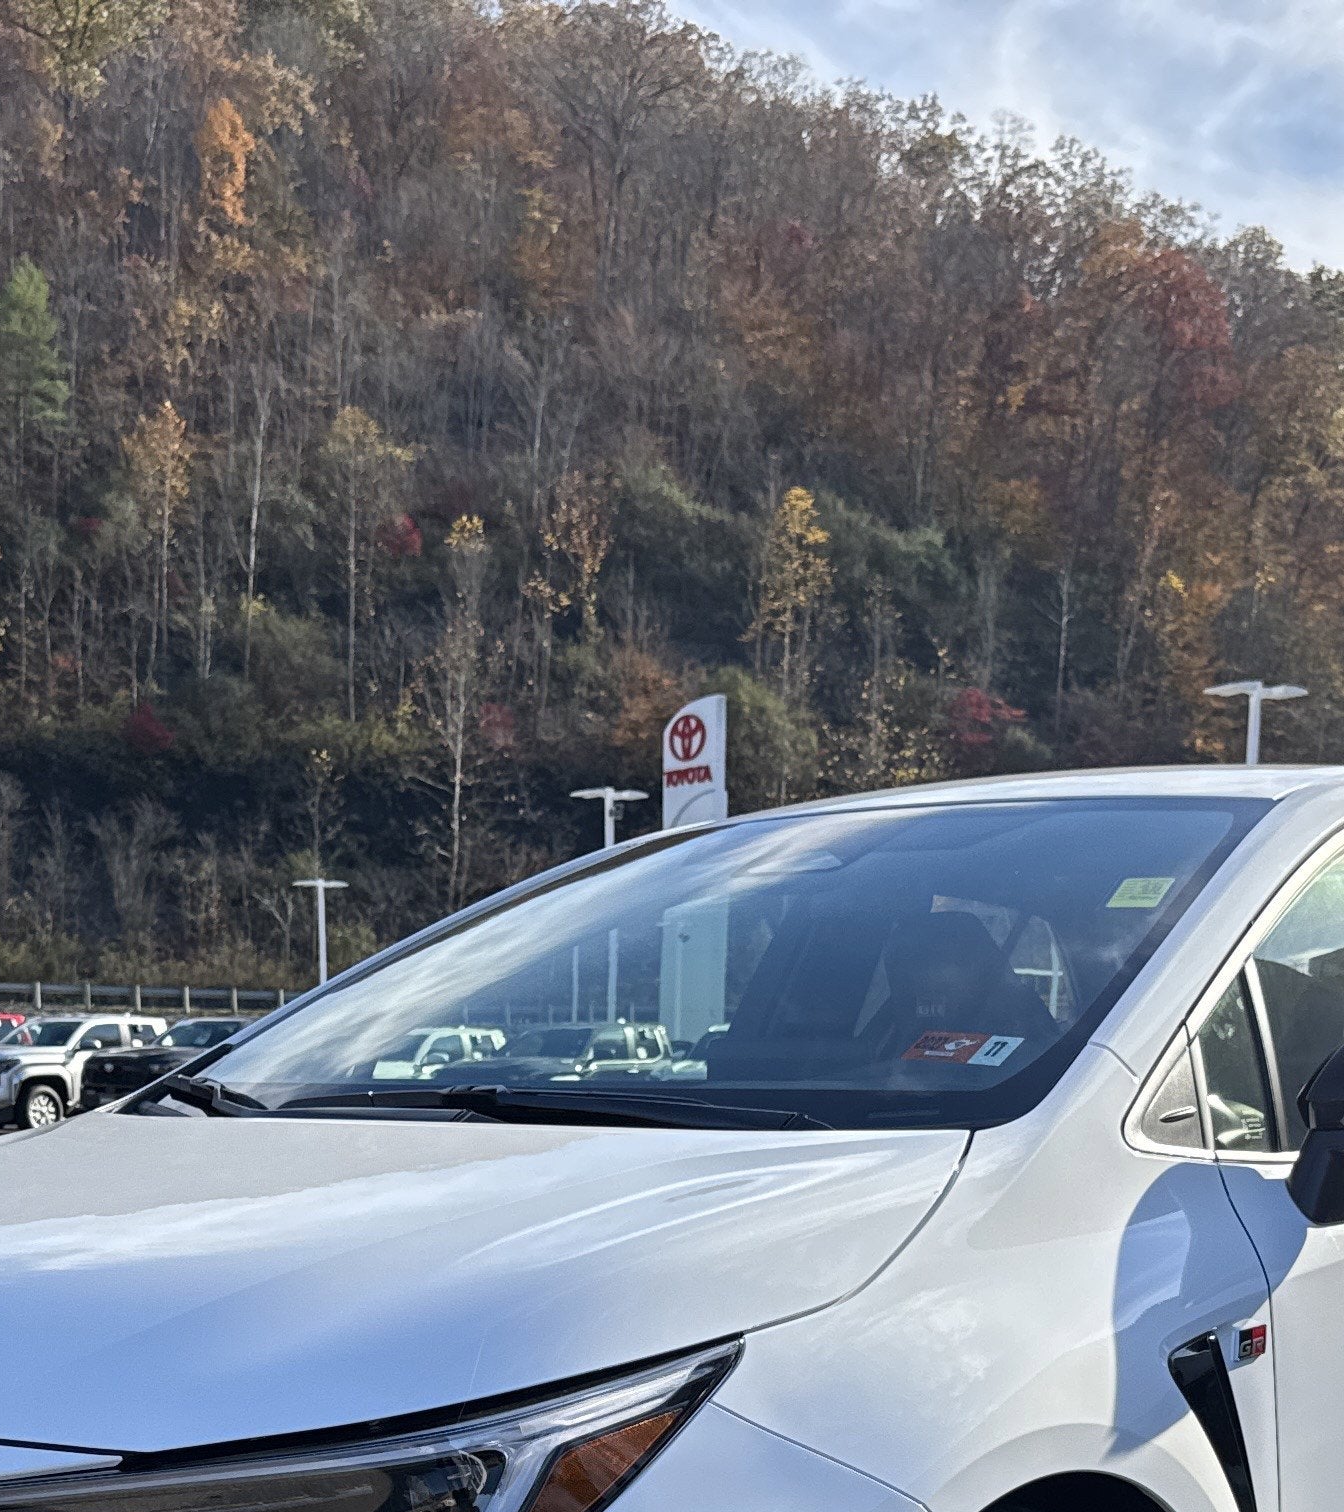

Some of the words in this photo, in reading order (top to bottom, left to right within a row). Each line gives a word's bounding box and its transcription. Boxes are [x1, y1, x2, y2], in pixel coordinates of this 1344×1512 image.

[664, 766, 712, 787] TOYOTA
[984, 1041, 1008, 1057] 11
[1240, 1336, 1265, 1357] GR
